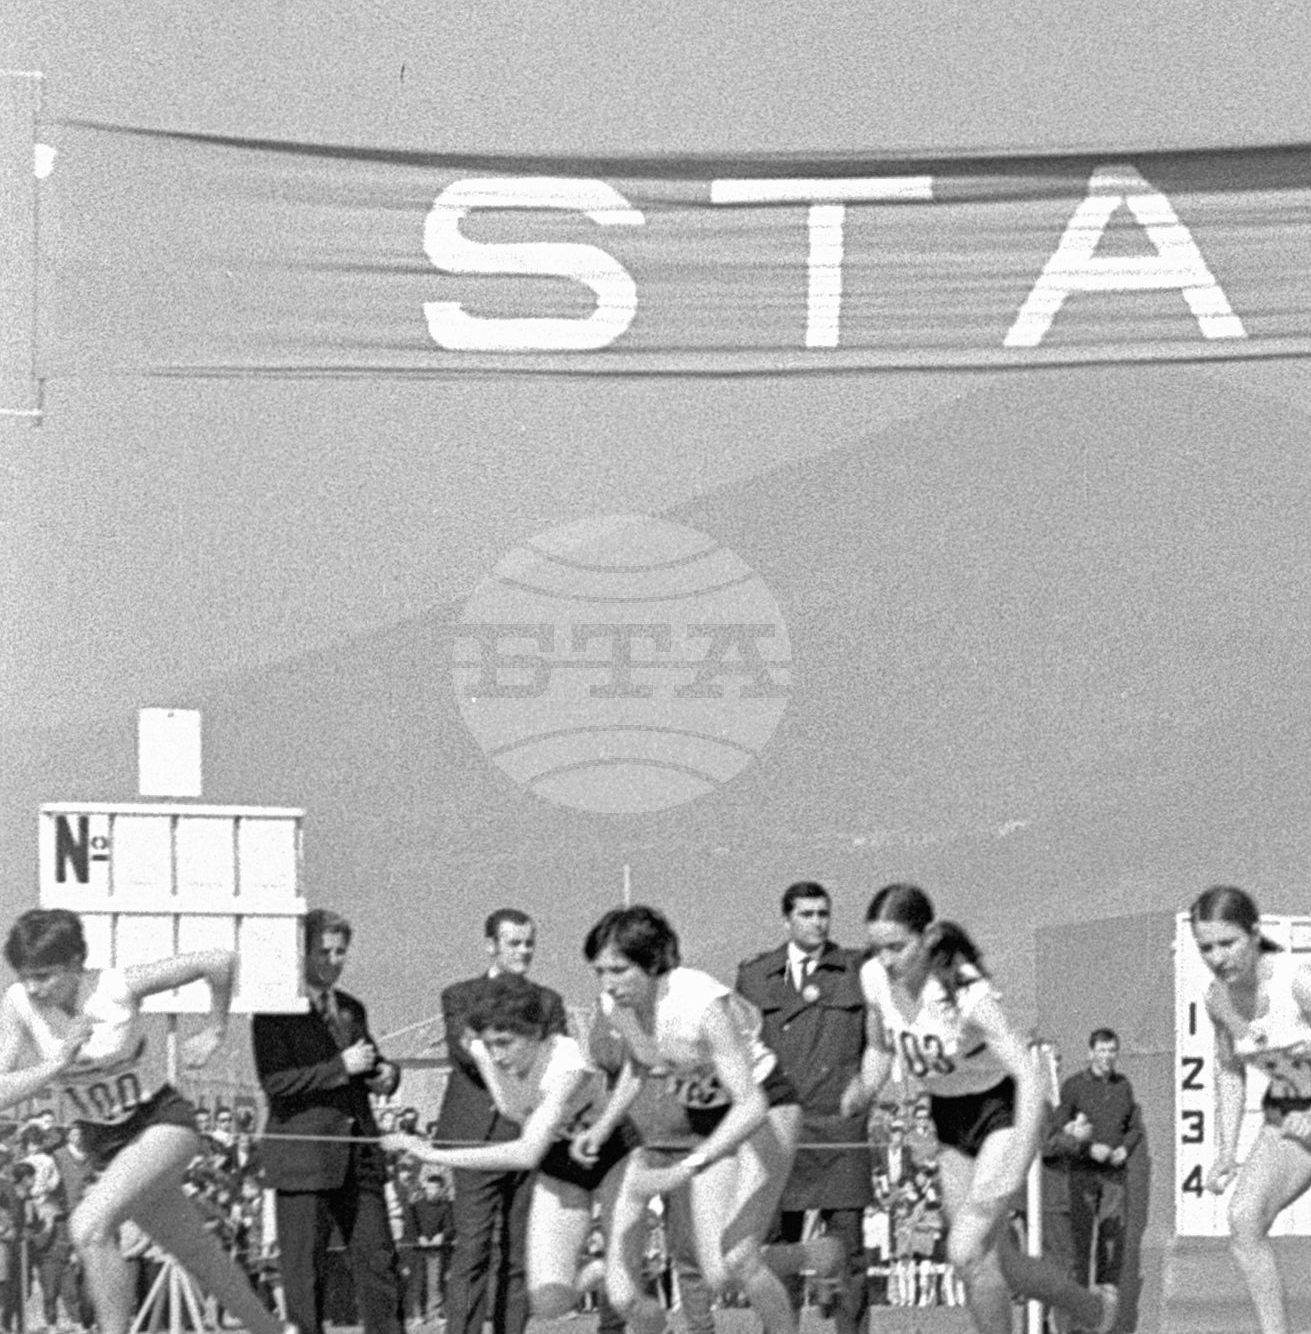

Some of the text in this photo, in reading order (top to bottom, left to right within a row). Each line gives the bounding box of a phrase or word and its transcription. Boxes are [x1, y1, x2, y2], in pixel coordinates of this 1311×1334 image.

[1182, 1057, 1204, 1090] 2
[1182, 1110, 1204, 1144] 3
[1182, 1164, 1204, 1197] 4
